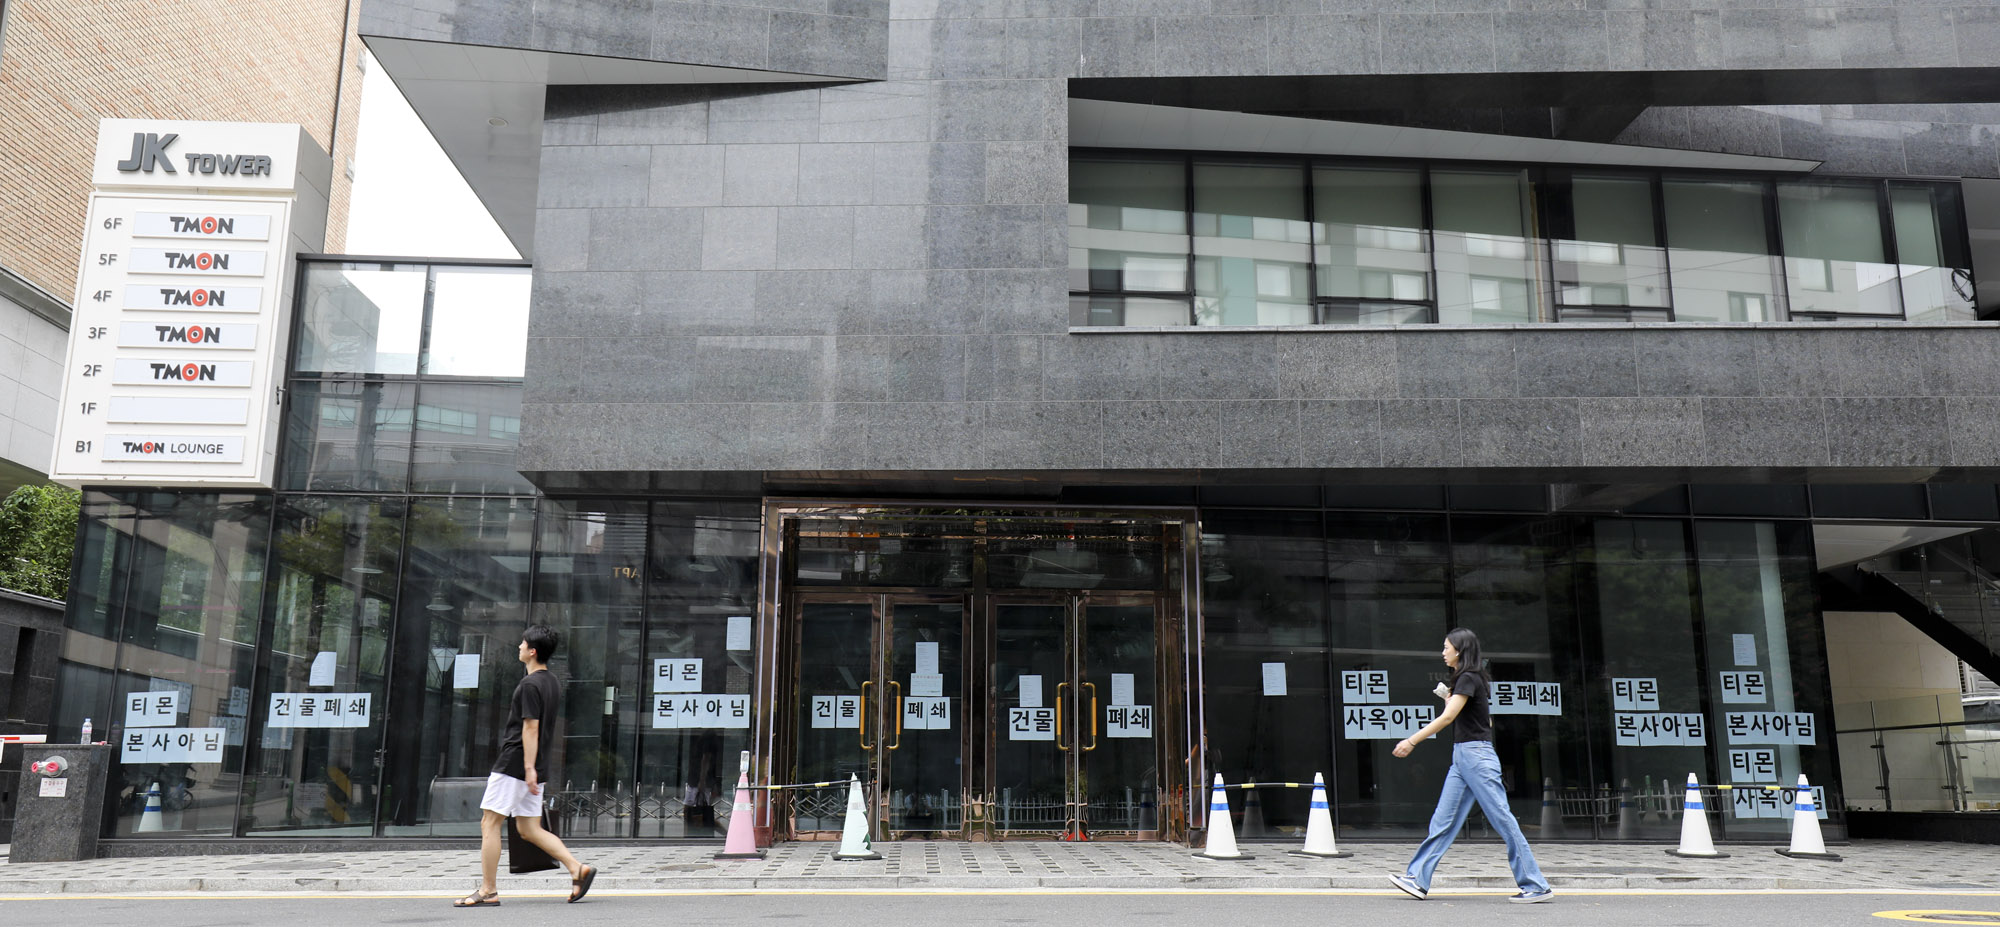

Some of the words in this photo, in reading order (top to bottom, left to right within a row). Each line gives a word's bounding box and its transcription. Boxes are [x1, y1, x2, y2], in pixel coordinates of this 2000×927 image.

[117, 132, 179, 174] JK
[185, 153, 272, 177] TOWER
[103, 217, 123, 230] 6F
[169, 216, 234, 235] TMON
[98, 253, 118, 266] 5F
[164, 252, 229, 270] TMON
[92, 290, 113, 303] 4F
[160, 288, 225, 307] TMON
[87, 326, 108, 340] 3F
[154, 325, 220, 344] TMON
[82, 364, 102, 377] 2F
[149, 362, 216, 382] TMON
[80, 402, 97, 415] 1F
[75, 440, 92, 454] B1
[122, 441, 165, 455] TMON
[170, 443, 224, 455] LOUNGE
[659, 663, 699, 682] 티몬
[1345, 672, 1388, 695] 티몬
[1615, 679, 1657, 702] 티몬
[1723, 673, 1764, 696] 티몬
[1488, 683, 1559, 707] 물폐쇄
[131, 696, 174, 716] 티몬
[274, 697, 366, 717] 건물폐쇄
[657, 698, 745, 717] 본사아님
[816, 700, 857, 718] 건물
[907, 701, 946, 719] 폐쇄
[1011, 709, 1054, 733] 건물
[1108, 707, 1150, 730] 폐쇄
[1617, 713, 1703, 738] 본사아님
[1728, 713, 1812, 738] 본사아님
[126, 732, 219, 752] 본사아님
[1732, 751, 1774, 775] 티몬
